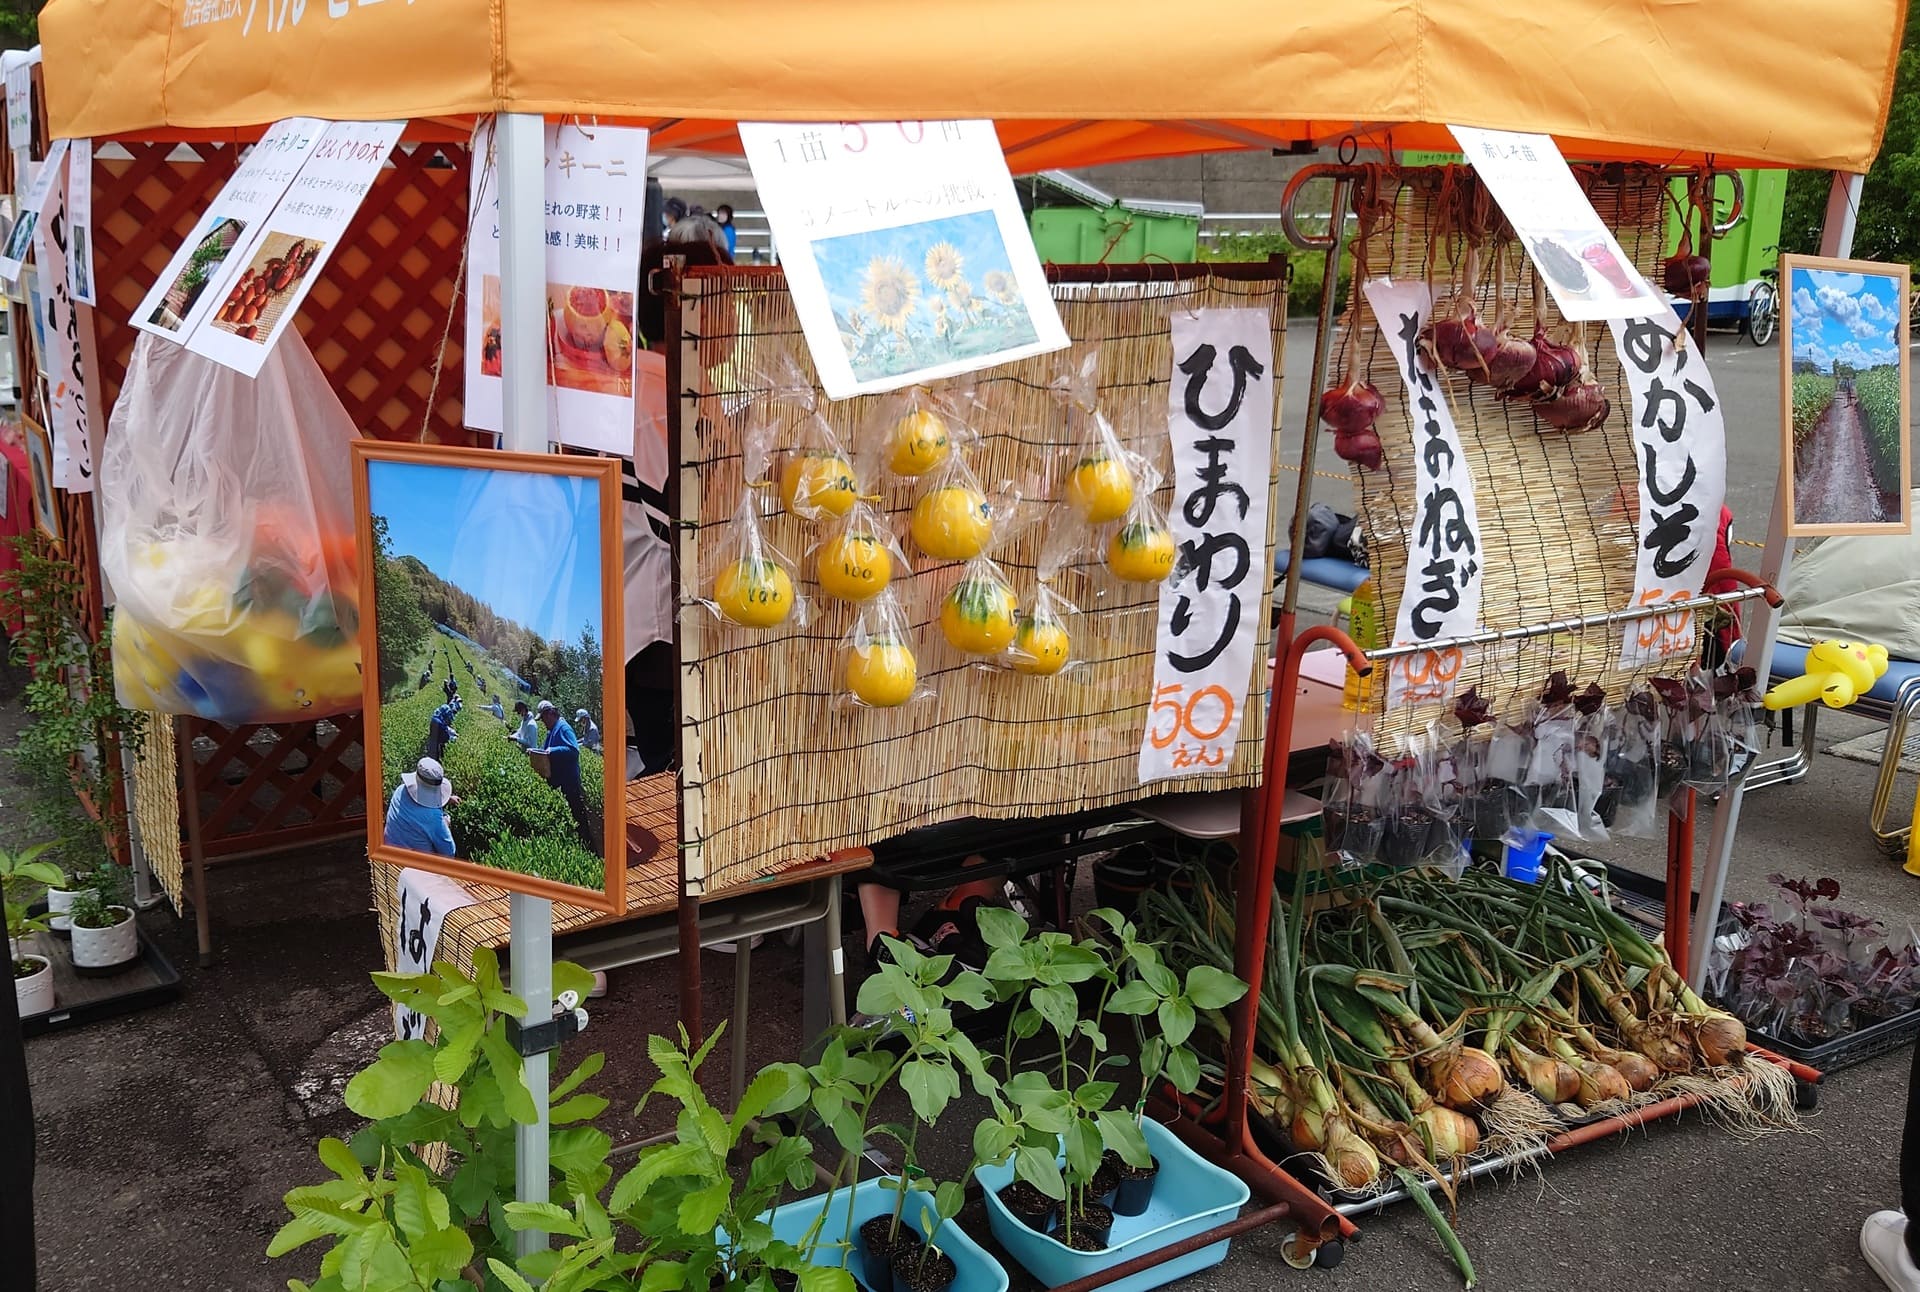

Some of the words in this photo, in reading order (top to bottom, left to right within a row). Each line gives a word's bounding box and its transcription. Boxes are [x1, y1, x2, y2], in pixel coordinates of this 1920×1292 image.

[315, 139, 385, 164] どんぐりの木
[1481, 142, 1538, 162] 赤しそ苗
[1166, 343, 1264, 674] ひまわり
[844, 562, 873, 580] 100
[1151, 681, 1235, 750] 50
[1171, 742, 1224, 769] えん
